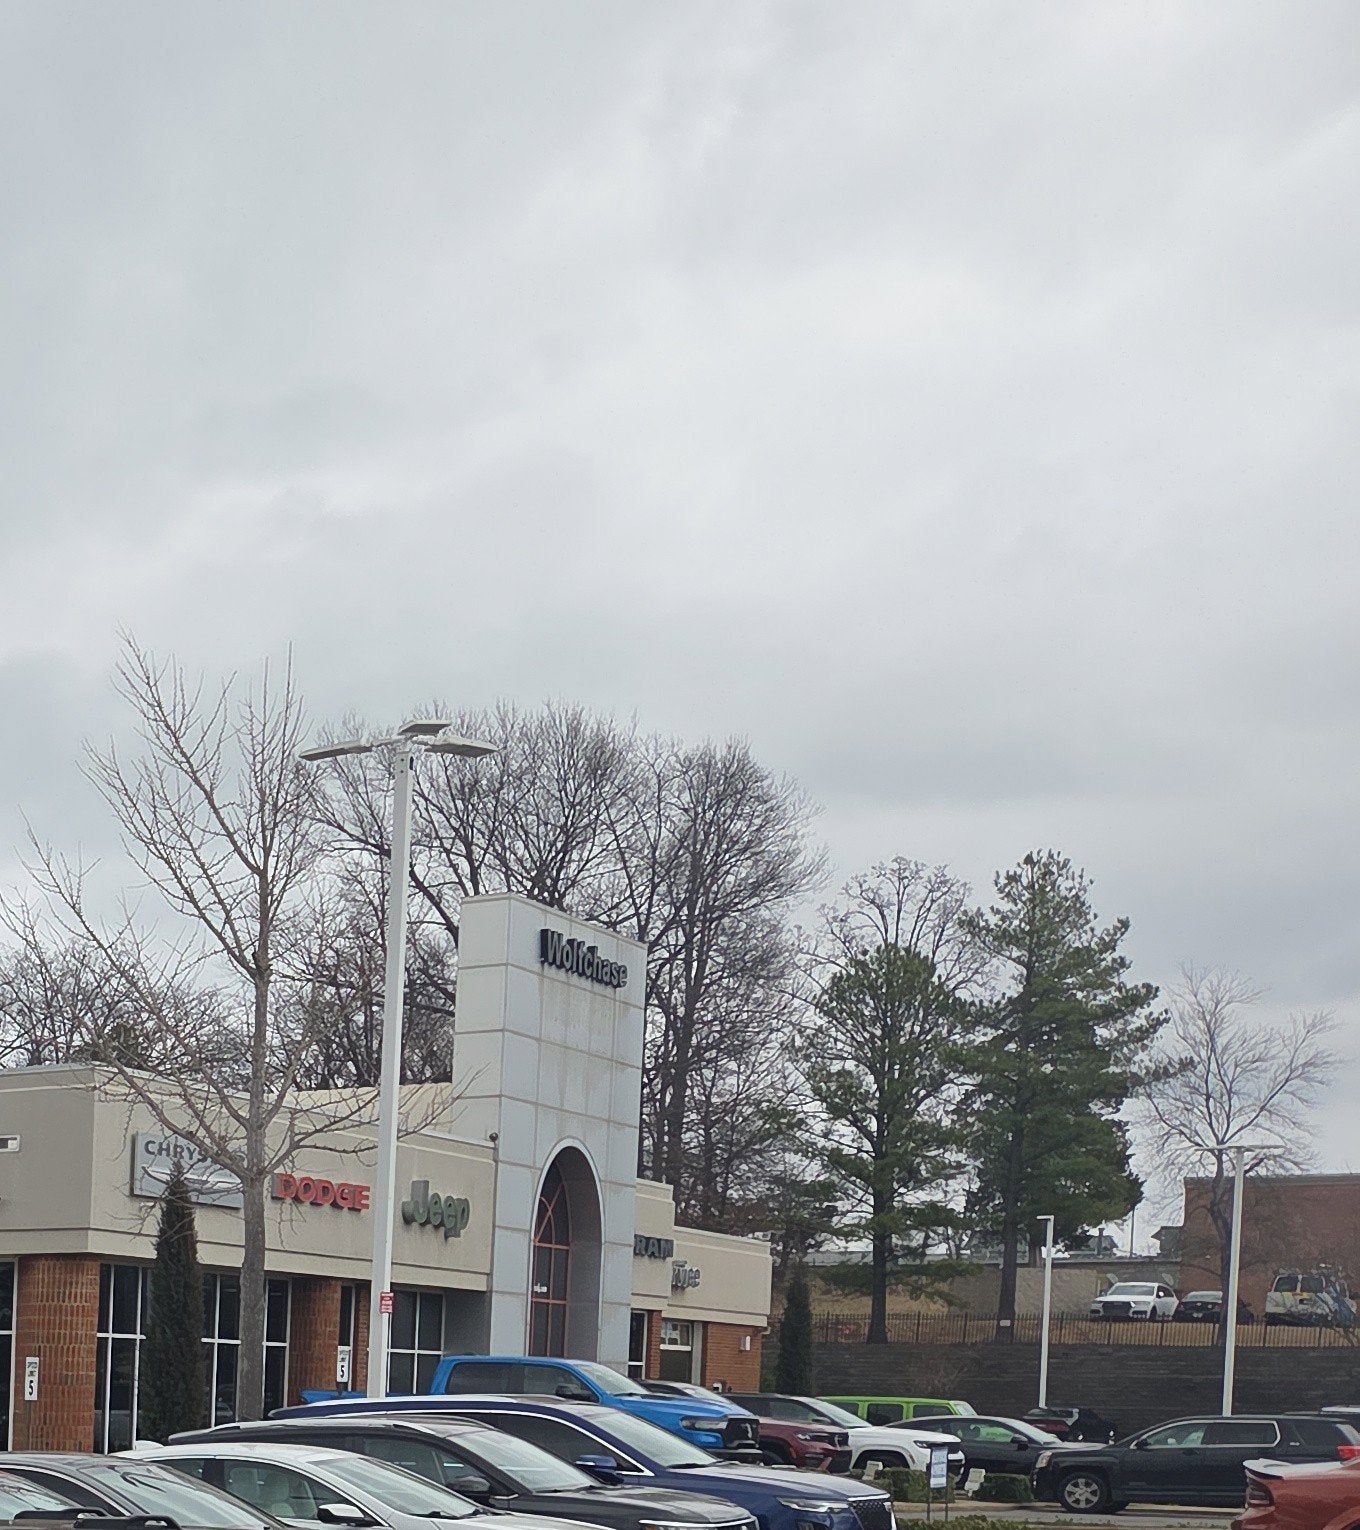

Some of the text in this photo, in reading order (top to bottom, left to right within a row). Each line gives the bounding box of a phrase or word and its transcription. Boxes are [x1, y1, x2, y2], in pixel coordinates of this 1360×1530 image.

[540, 928, 628, 988] Wolfchase
[271, 1173, 371, 1212] DODGE
[401, 1180, 470, 1239] Jeep
[634, 1234, 675, 1259] RAM
[28, 1379, 34, 1396] 5
[340, 1364, 346, 1379] 5
